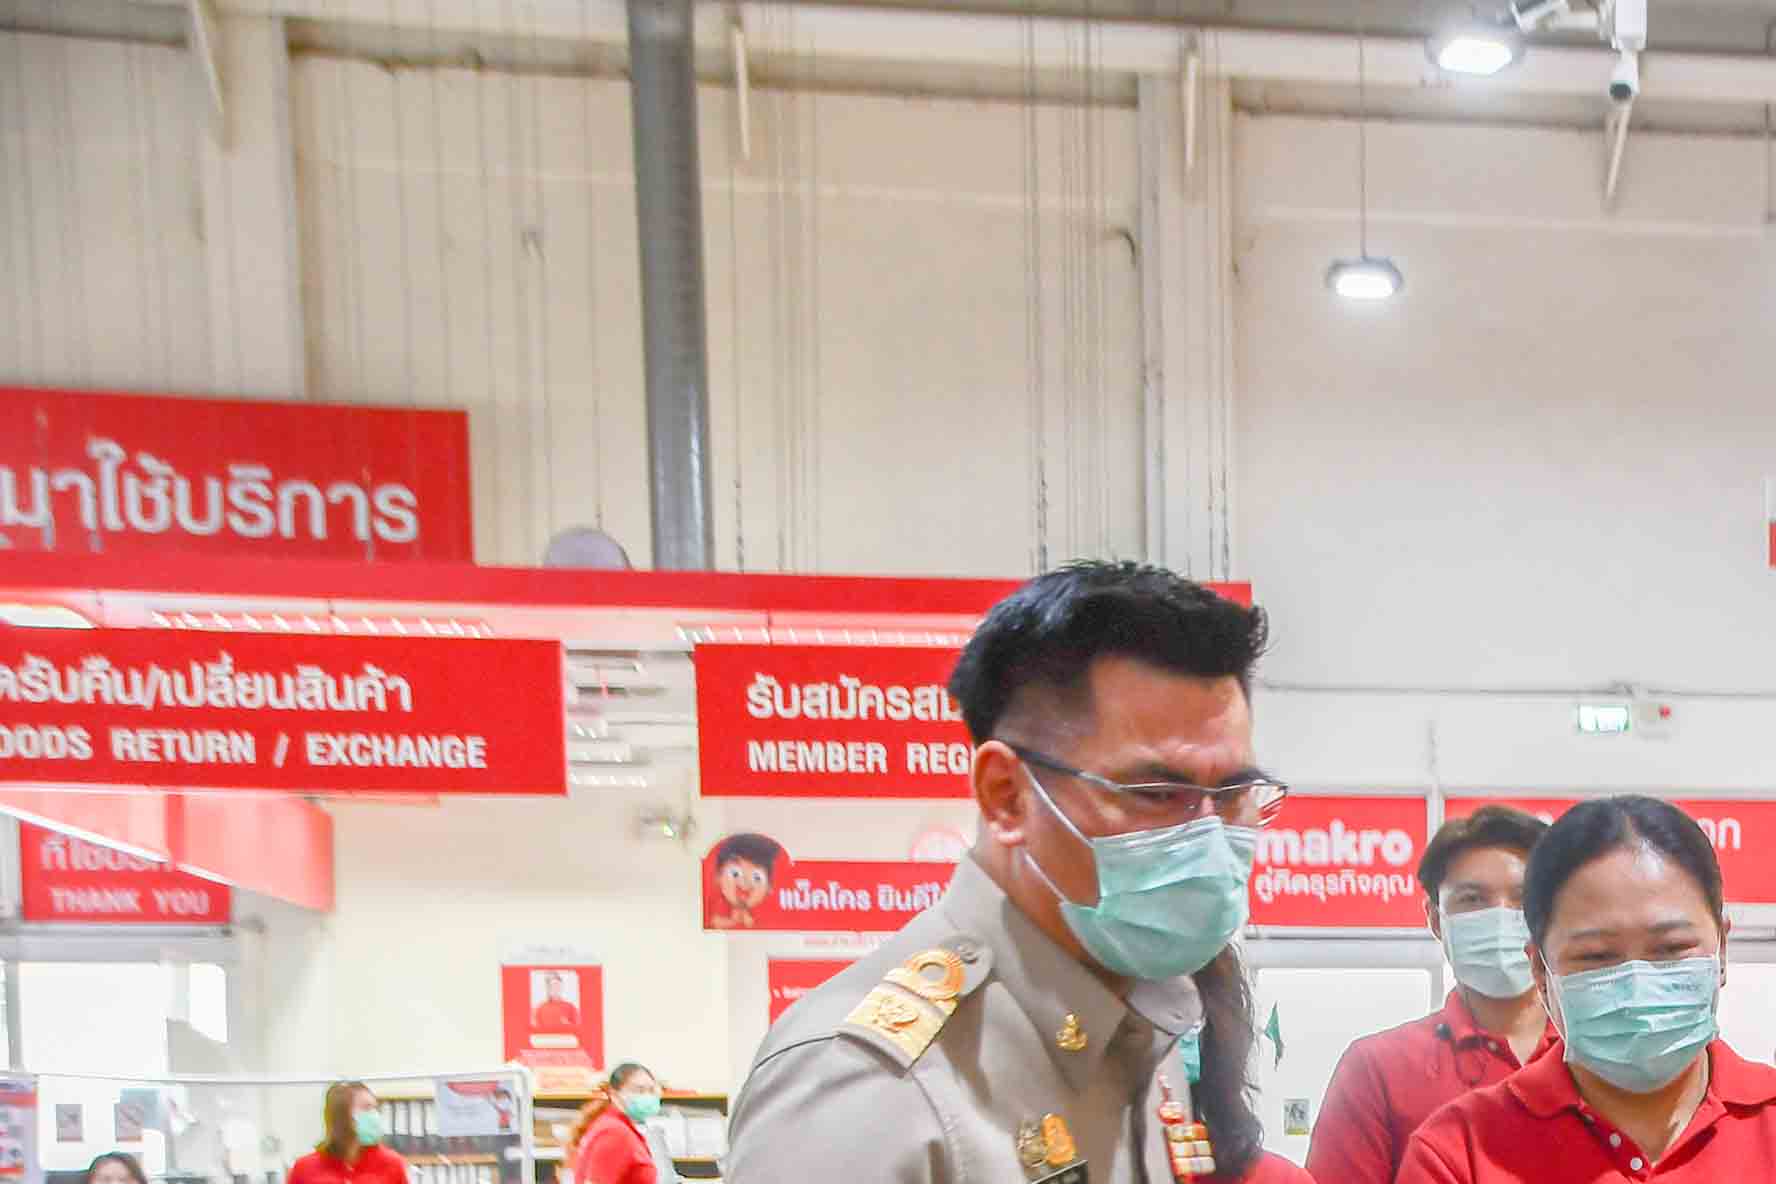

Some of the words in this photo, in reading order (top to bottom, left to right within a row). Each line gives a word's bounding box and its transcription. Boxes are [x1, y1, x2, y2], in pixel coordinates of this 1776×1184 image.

[109, 726, 256, 764] RETURN
[305, 731, 487, 769] EXCHANGE
[746, 740, 888, 774] MEMBER
[1255, 819, 1413, 866] makro
[51, 887, 143, 914] THANK
[152, 888, 211, 916] YOU
